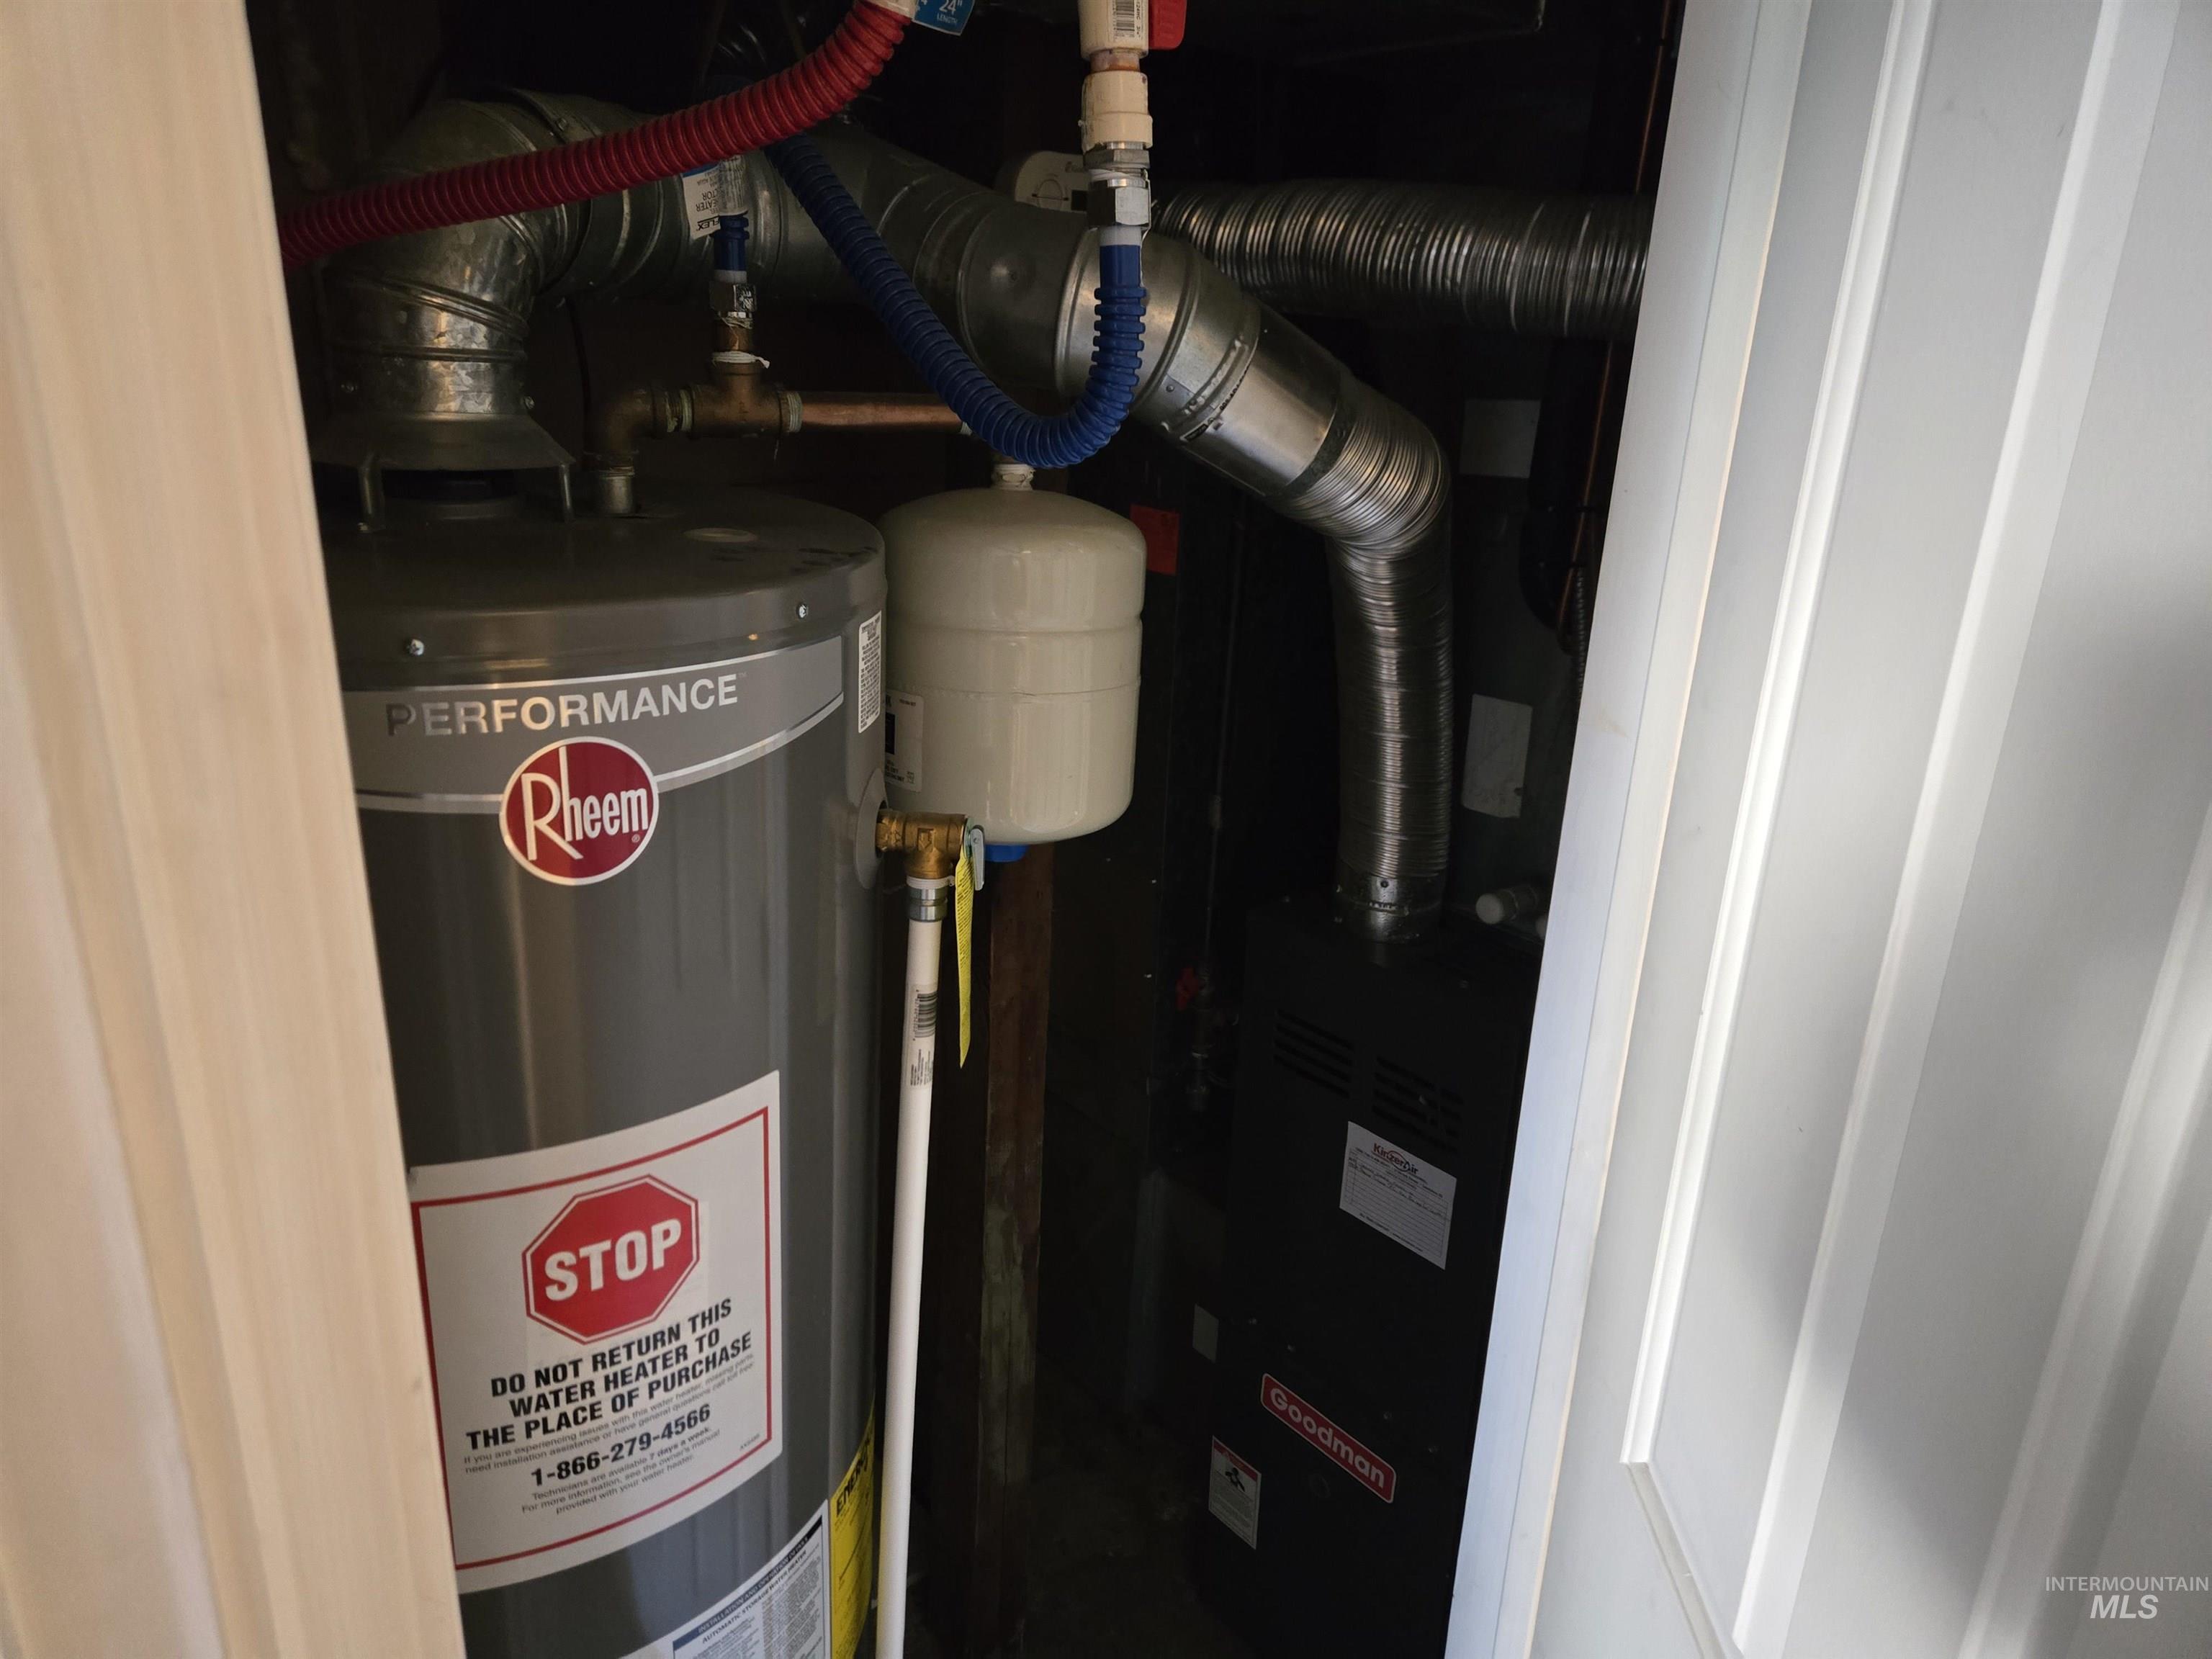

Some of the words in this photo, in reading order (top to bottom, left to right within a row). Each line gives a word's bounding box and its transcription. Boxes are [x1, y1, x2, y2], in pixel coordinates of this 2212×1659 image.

[936, 12, 958, 25] LENGTH
[385, 673, 738, 736] PERFORMANCE
[521, 747, 648, 860] Rheem
[544, 1218, 683, 1301] STOP
[491, 1373, 526, 1397] DO
[535, 1358, 583, 1388] NOT
[592, 1323, 680, 1372] RETURN
[688, 1298, 732, 1334] THIS
[509, 1380, 595, 1418] WATER
[604, 1344, 688, 1393] HEATER
[695, 1328, 720, 1354] TO
[464, 1455, 470, 1464] If
[473, 1453, 492, 1464] you
[495, 1450, 512, 1459] are
[514, 1433, 577, 1455] experiencing
[579, 1423, 609, 1437] issues
[612, 1415, 630, 1426] with
[632, 1406, 647, 1419] this
[650, 1395, 673, 1411] water
[465, 1462, 491, 1474] need
[494, 1451, 547, 1469] installation
[549, 1435, 601, 1456] assistance
[602, 1431, 611, 1440] or
[614, 1423, 635, 1435] have
[639, 1409, 671, 1428] general
[673, 1388, 711, 1411] questions
[466, 1424, 516, 1450] THE
[525, 1401, 603, 1439] PLACE
[611, 1388, 639, 1413] OF
[648, 1330, 752, 1400] PURCHASE
[531, 1403, 711, 1486] 1-866-279-4566
[532, 1480, 588, 1501] Technicians
[590, 1473, 606, 1483] are
[608, 1457, 647, 1479] available
[657, 1443, 679, 1457] days
[1270, 1387, 1384, 1488] Goodman
[522, 1503, 539, 1513] For
[541, 1496, 566, 1508] more
[625, 1470, 641, 1480] see
[643, 1462, 657, 1473] the
[556, 1496, 598, 1514] provided
[599, 1485, 619, 1502] with
[620, 1479, 639, 1494] your
[642, 1467, 665, 1482] water
